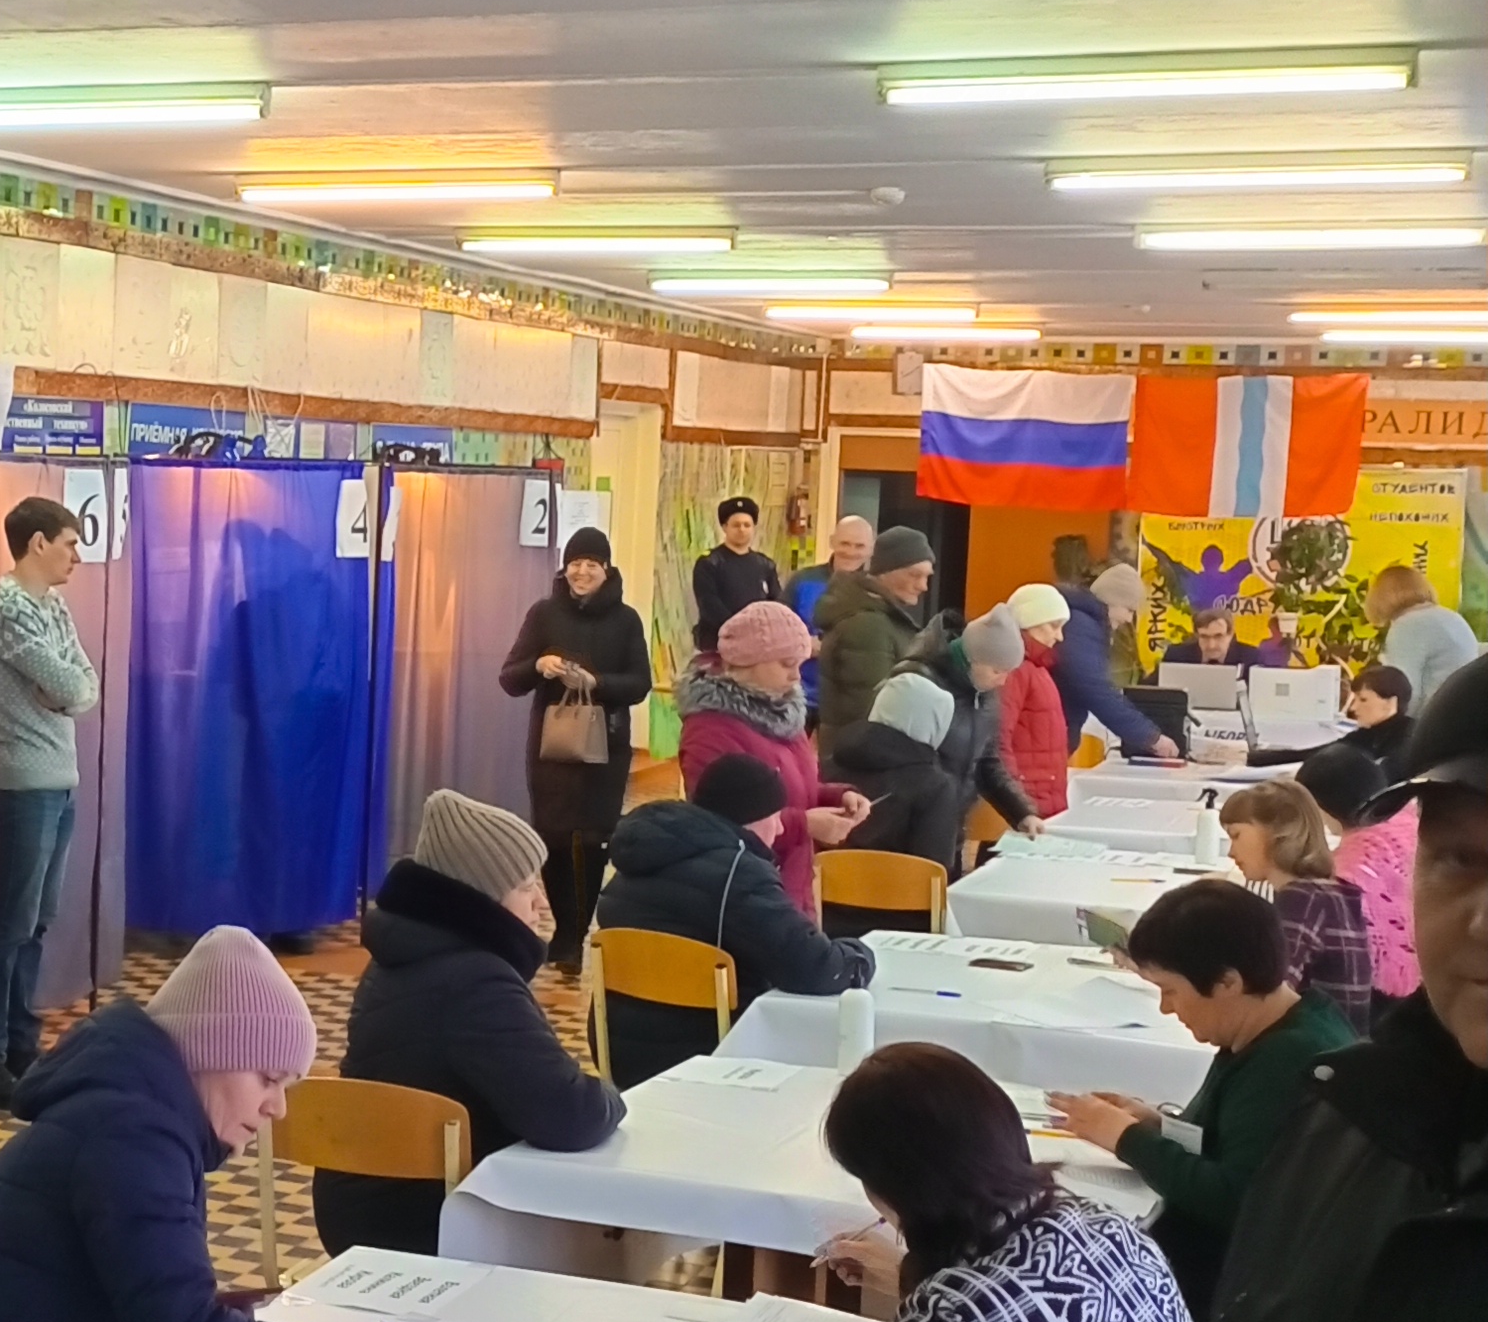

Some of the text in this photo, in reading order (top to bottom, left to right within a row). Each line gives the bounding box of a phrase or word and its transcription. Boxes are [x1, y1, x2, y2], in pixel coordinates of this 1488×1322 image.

[78, 493, 100, 547] 6
[350, 503, 368, 544] 4
[531, 498, 548, 534] 2
